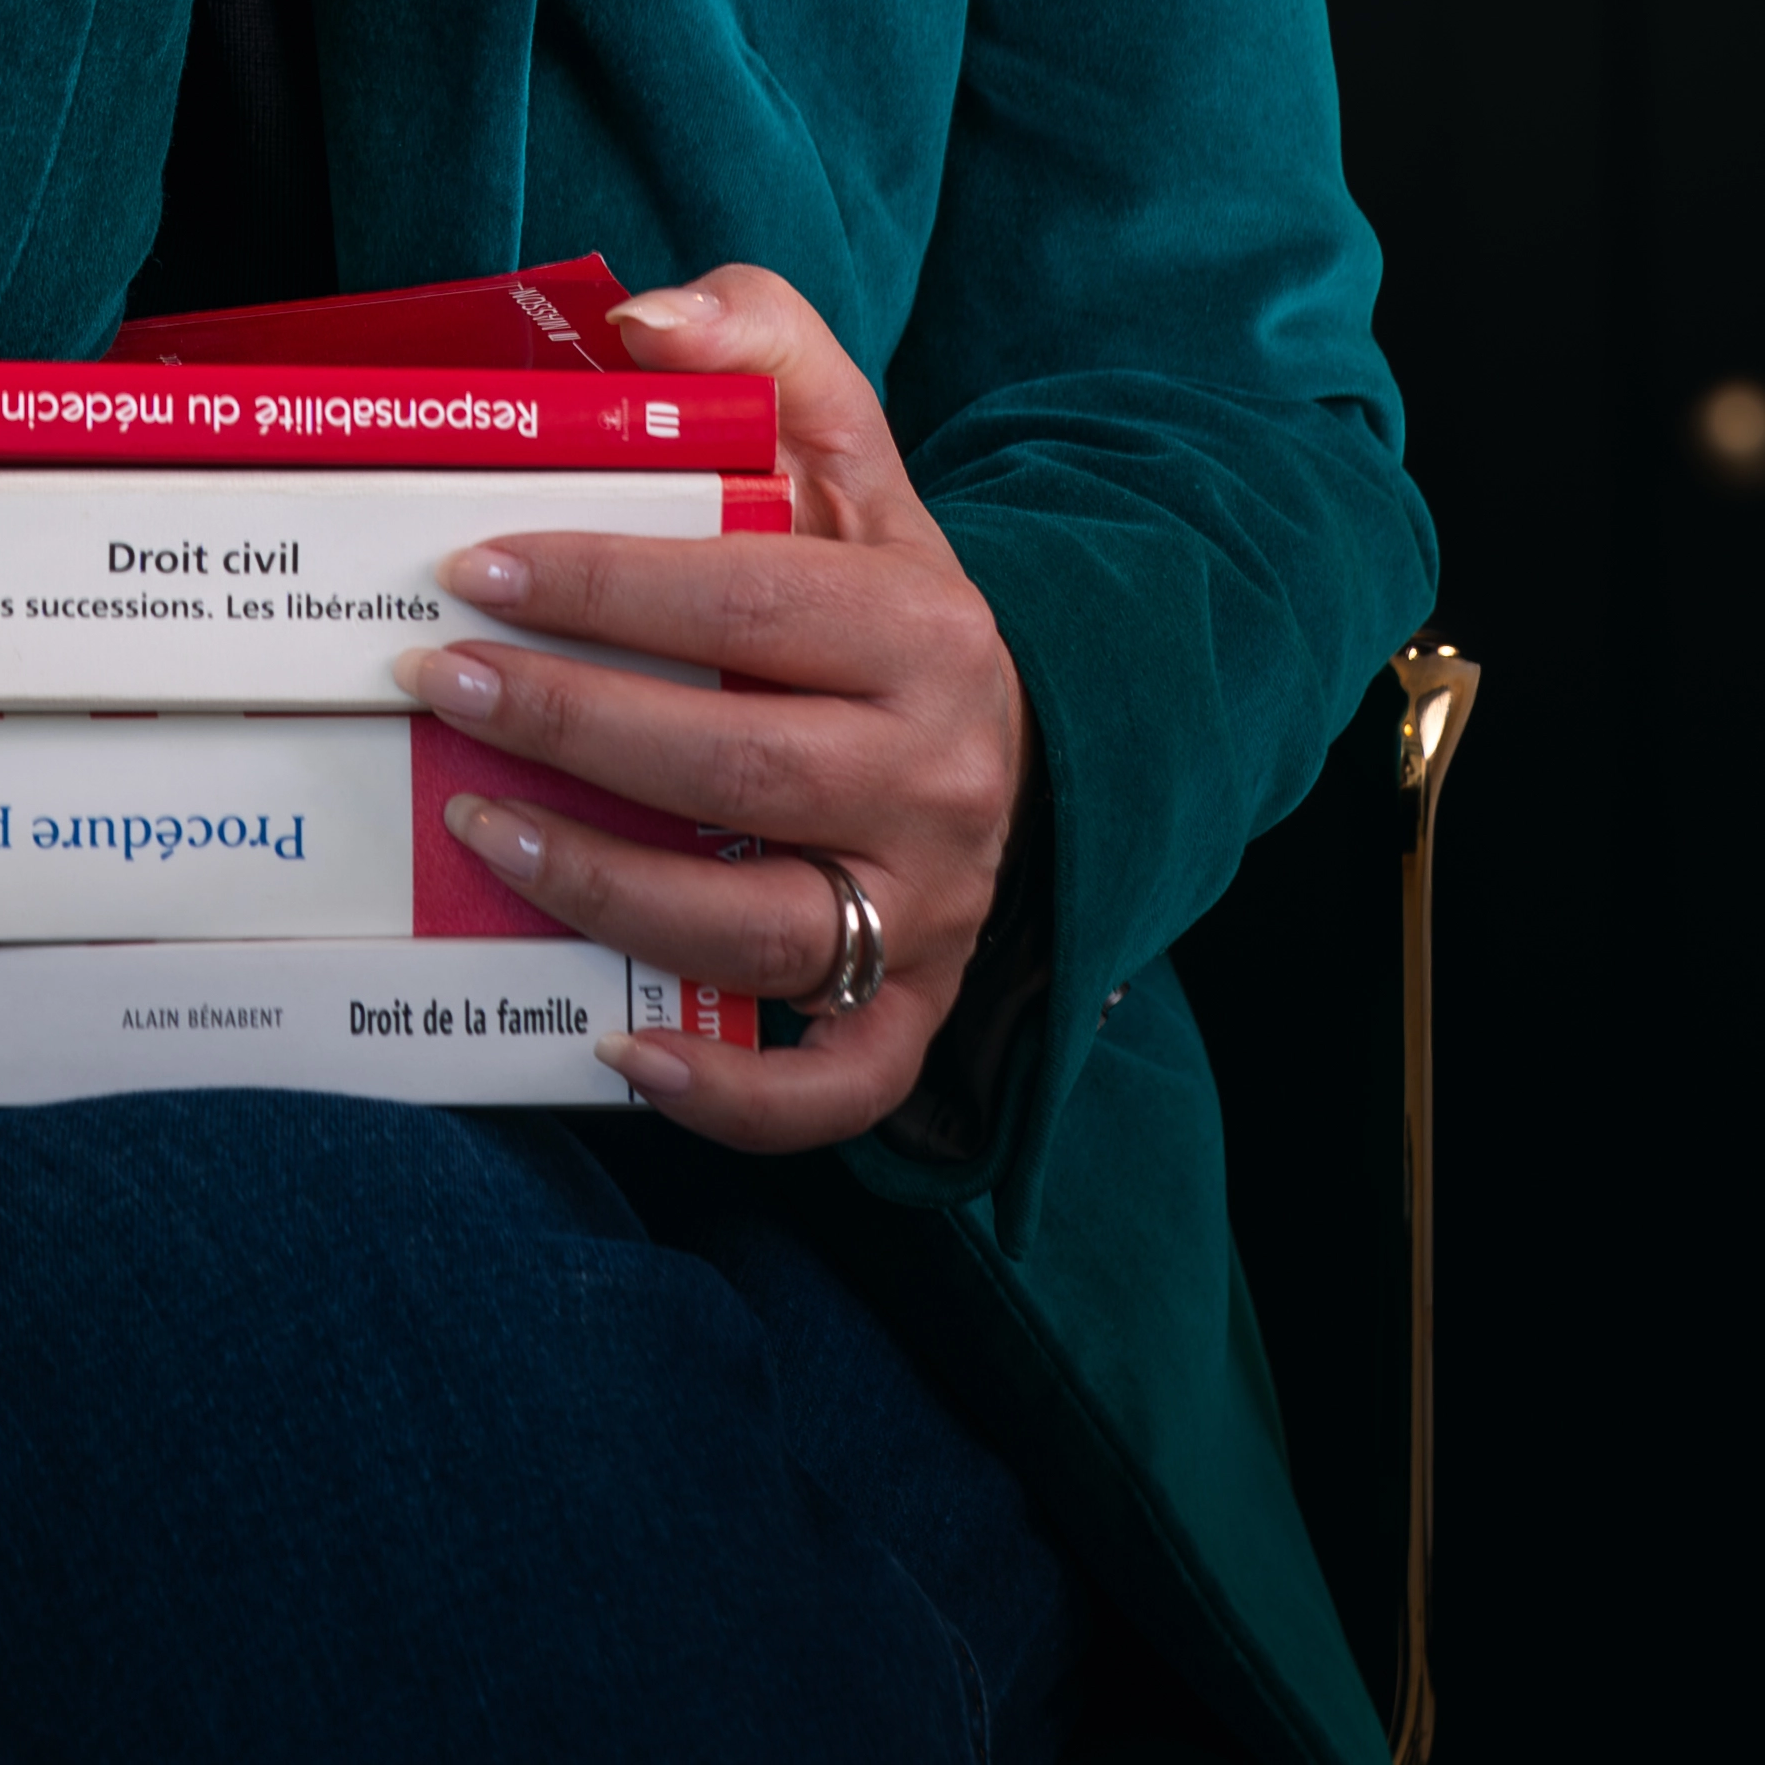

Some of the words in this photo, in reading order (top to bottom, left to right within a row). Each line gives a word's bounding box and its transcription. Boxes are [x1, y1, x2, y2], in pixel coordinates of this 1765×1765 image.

[509, 286, 572, 331] MASSON
[1, 390, 174, 434] médecin
[188, 394, 241, 434] du
[254, 390, 539, 439] Responsabilité
[108, 541, 208, 575] Droit
[222, 541, 299, 575] civil
[25, 592, 213, 620] successions.
[226, 594, 275, 620] Les
[286, 593, 441, 622] libéralités
[32, 814, 307, 861] Procédure
[121, 1008, 180, 1030] ALAIN
[187, 1002, 283, 1029] BÉNABENT
[349, 998, 413, 1037] Droit
[423, 998, 454, 1036] de
[464, 998, 487, 1036] la
[496, 997, 589, 1035] famille
[638, 983, 672, 1028] pri
